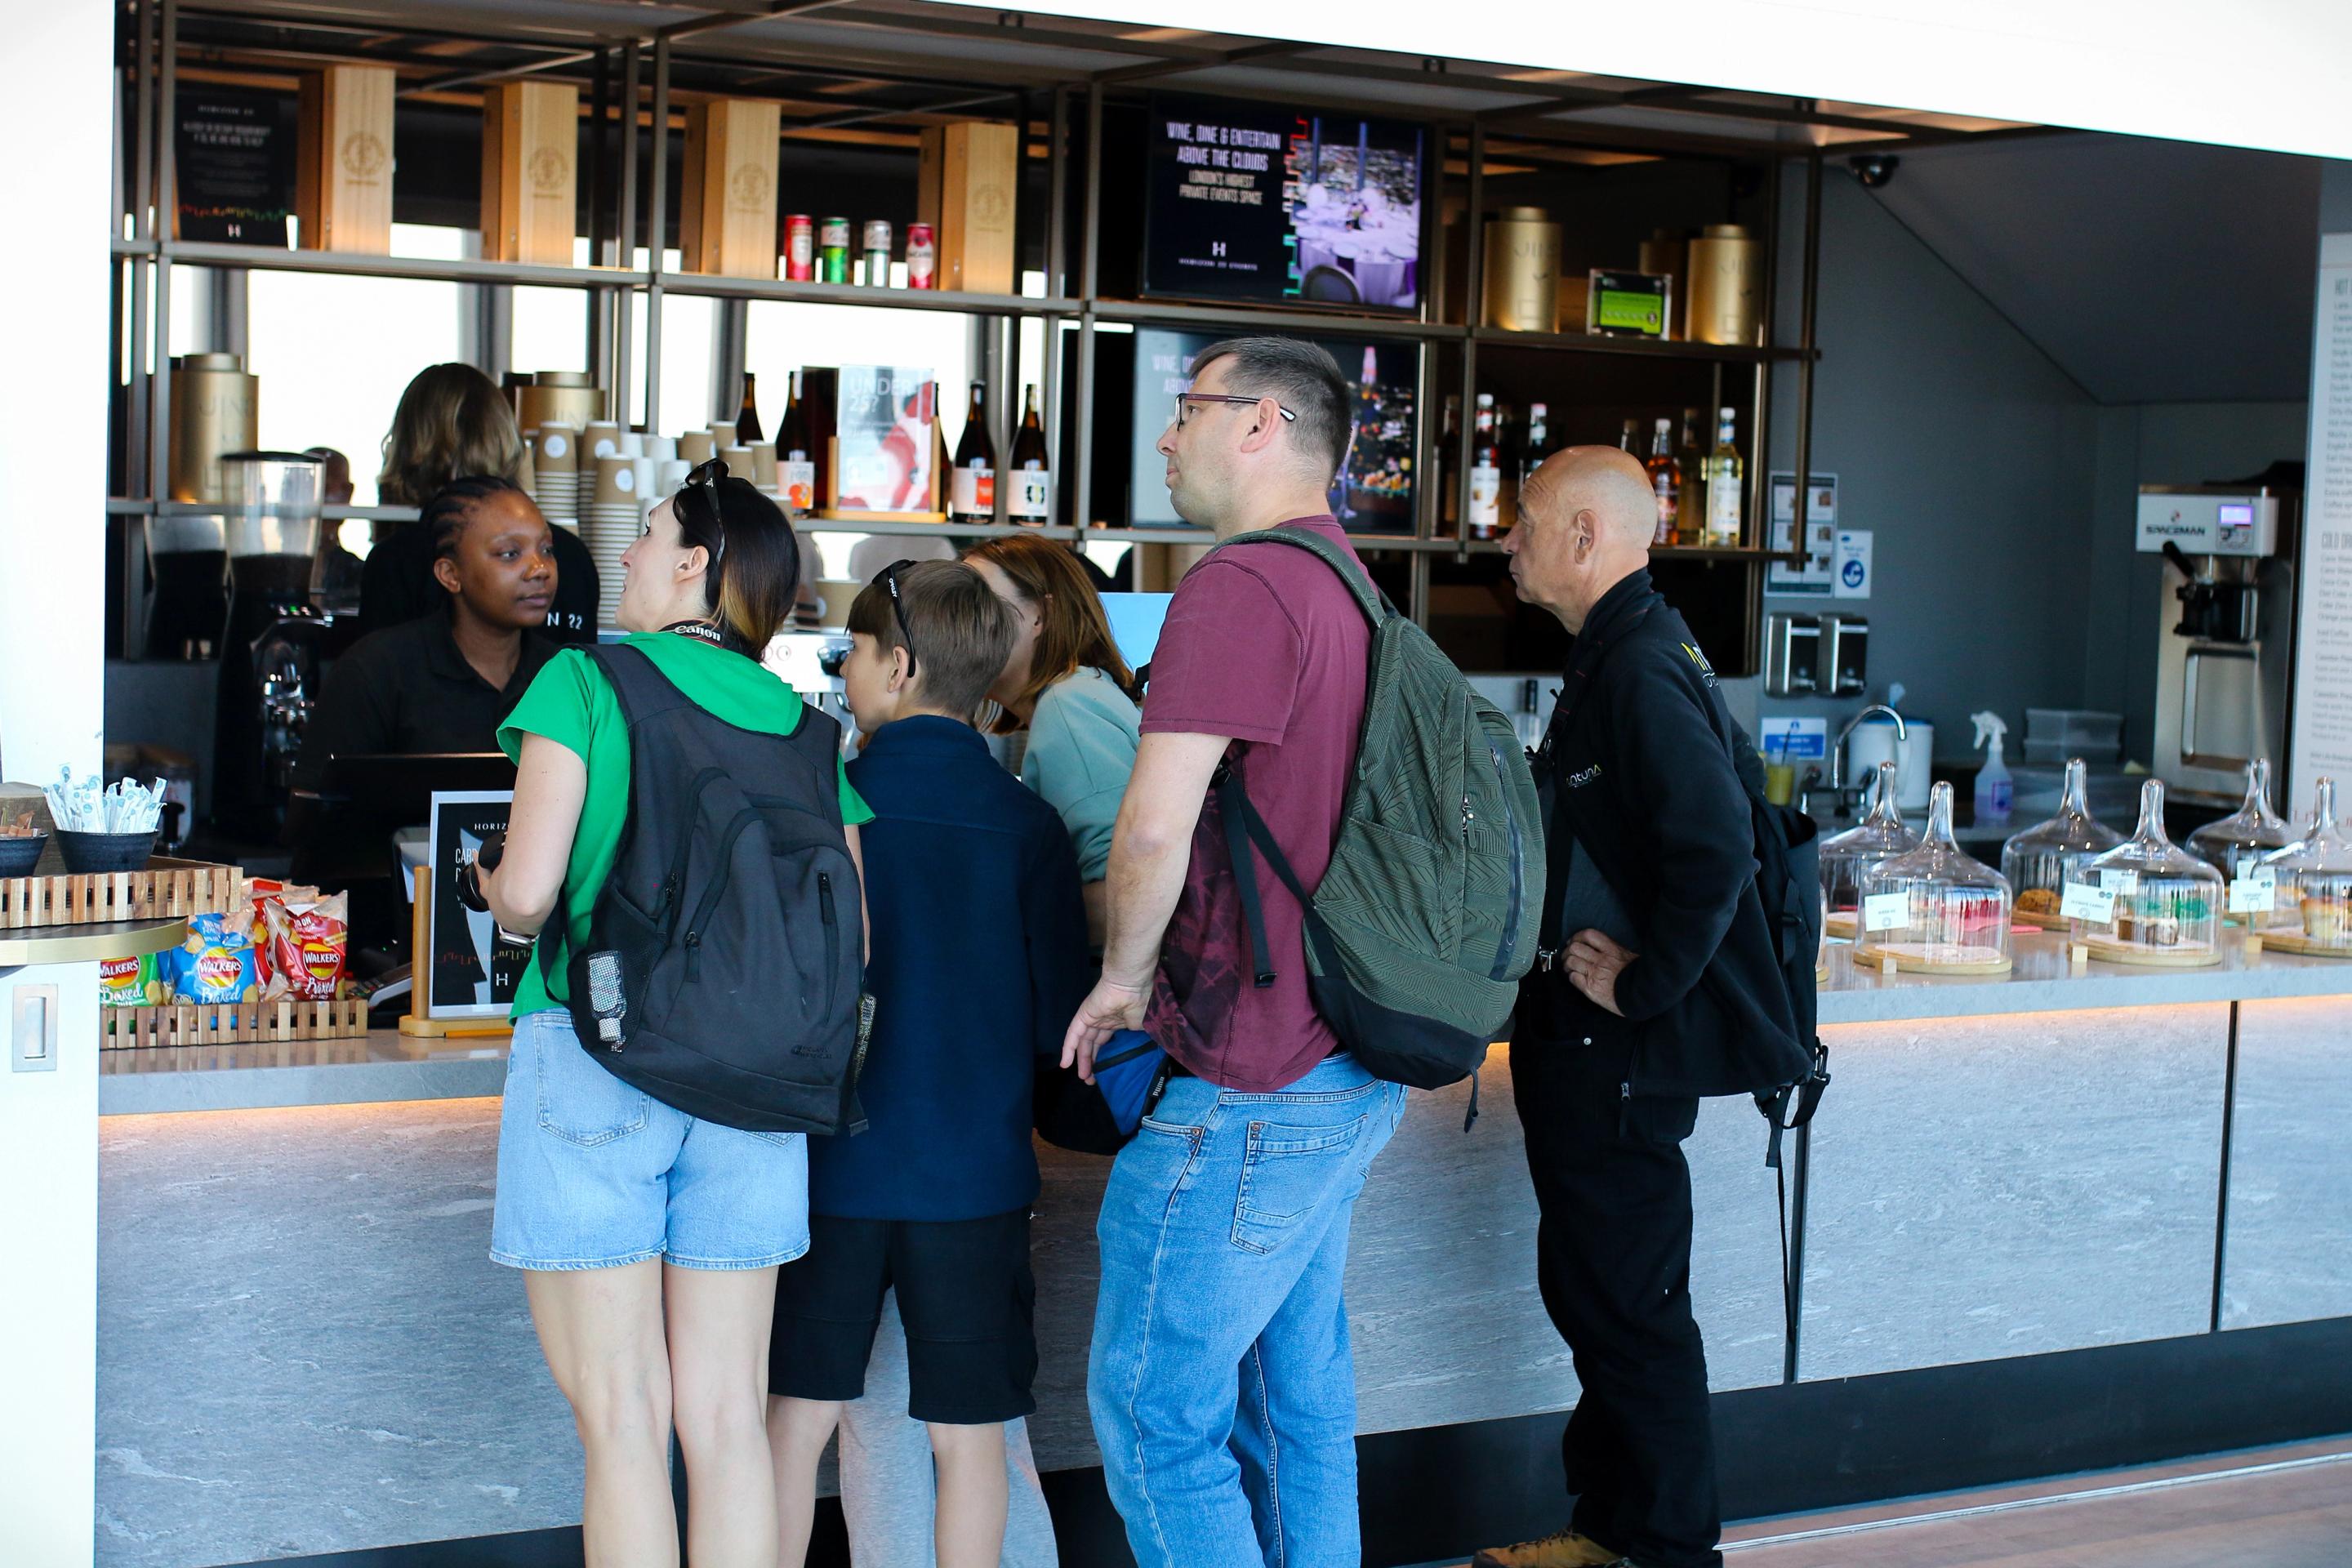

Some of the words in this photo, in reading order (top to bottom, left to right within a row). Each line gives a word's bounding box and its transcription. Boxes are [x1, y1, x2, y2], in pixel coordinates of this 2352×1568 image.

[1230, 128, 1281, 150] ENTERTAIN
[1176, 145, 1209, 166] ABOVE
[1211, 149, 1230, 167] THE
[1232, 151, 1269, 172] CLOUDS
[1179, 184, 1209, 201] PRIVATE
[1209, 187, 1239, 203] EVENTS
[1240, 189, 1263, 206] SPACE
[1213, 241, 1227, 257] H
[568, 613, 582, 630] 22
[674, 625, 721, 642] Canon
[474, 822, 509, 831] HORIZ
[199, 957, 242, 974] WALKERS
[303, 951, 340, 964] WALKERS
[305, 976, 336, 995] Baked
[496, 973, 508, 987] H
[99, 982, 144, 1004] Baked
[201, 986, 241, 1004] Baked
